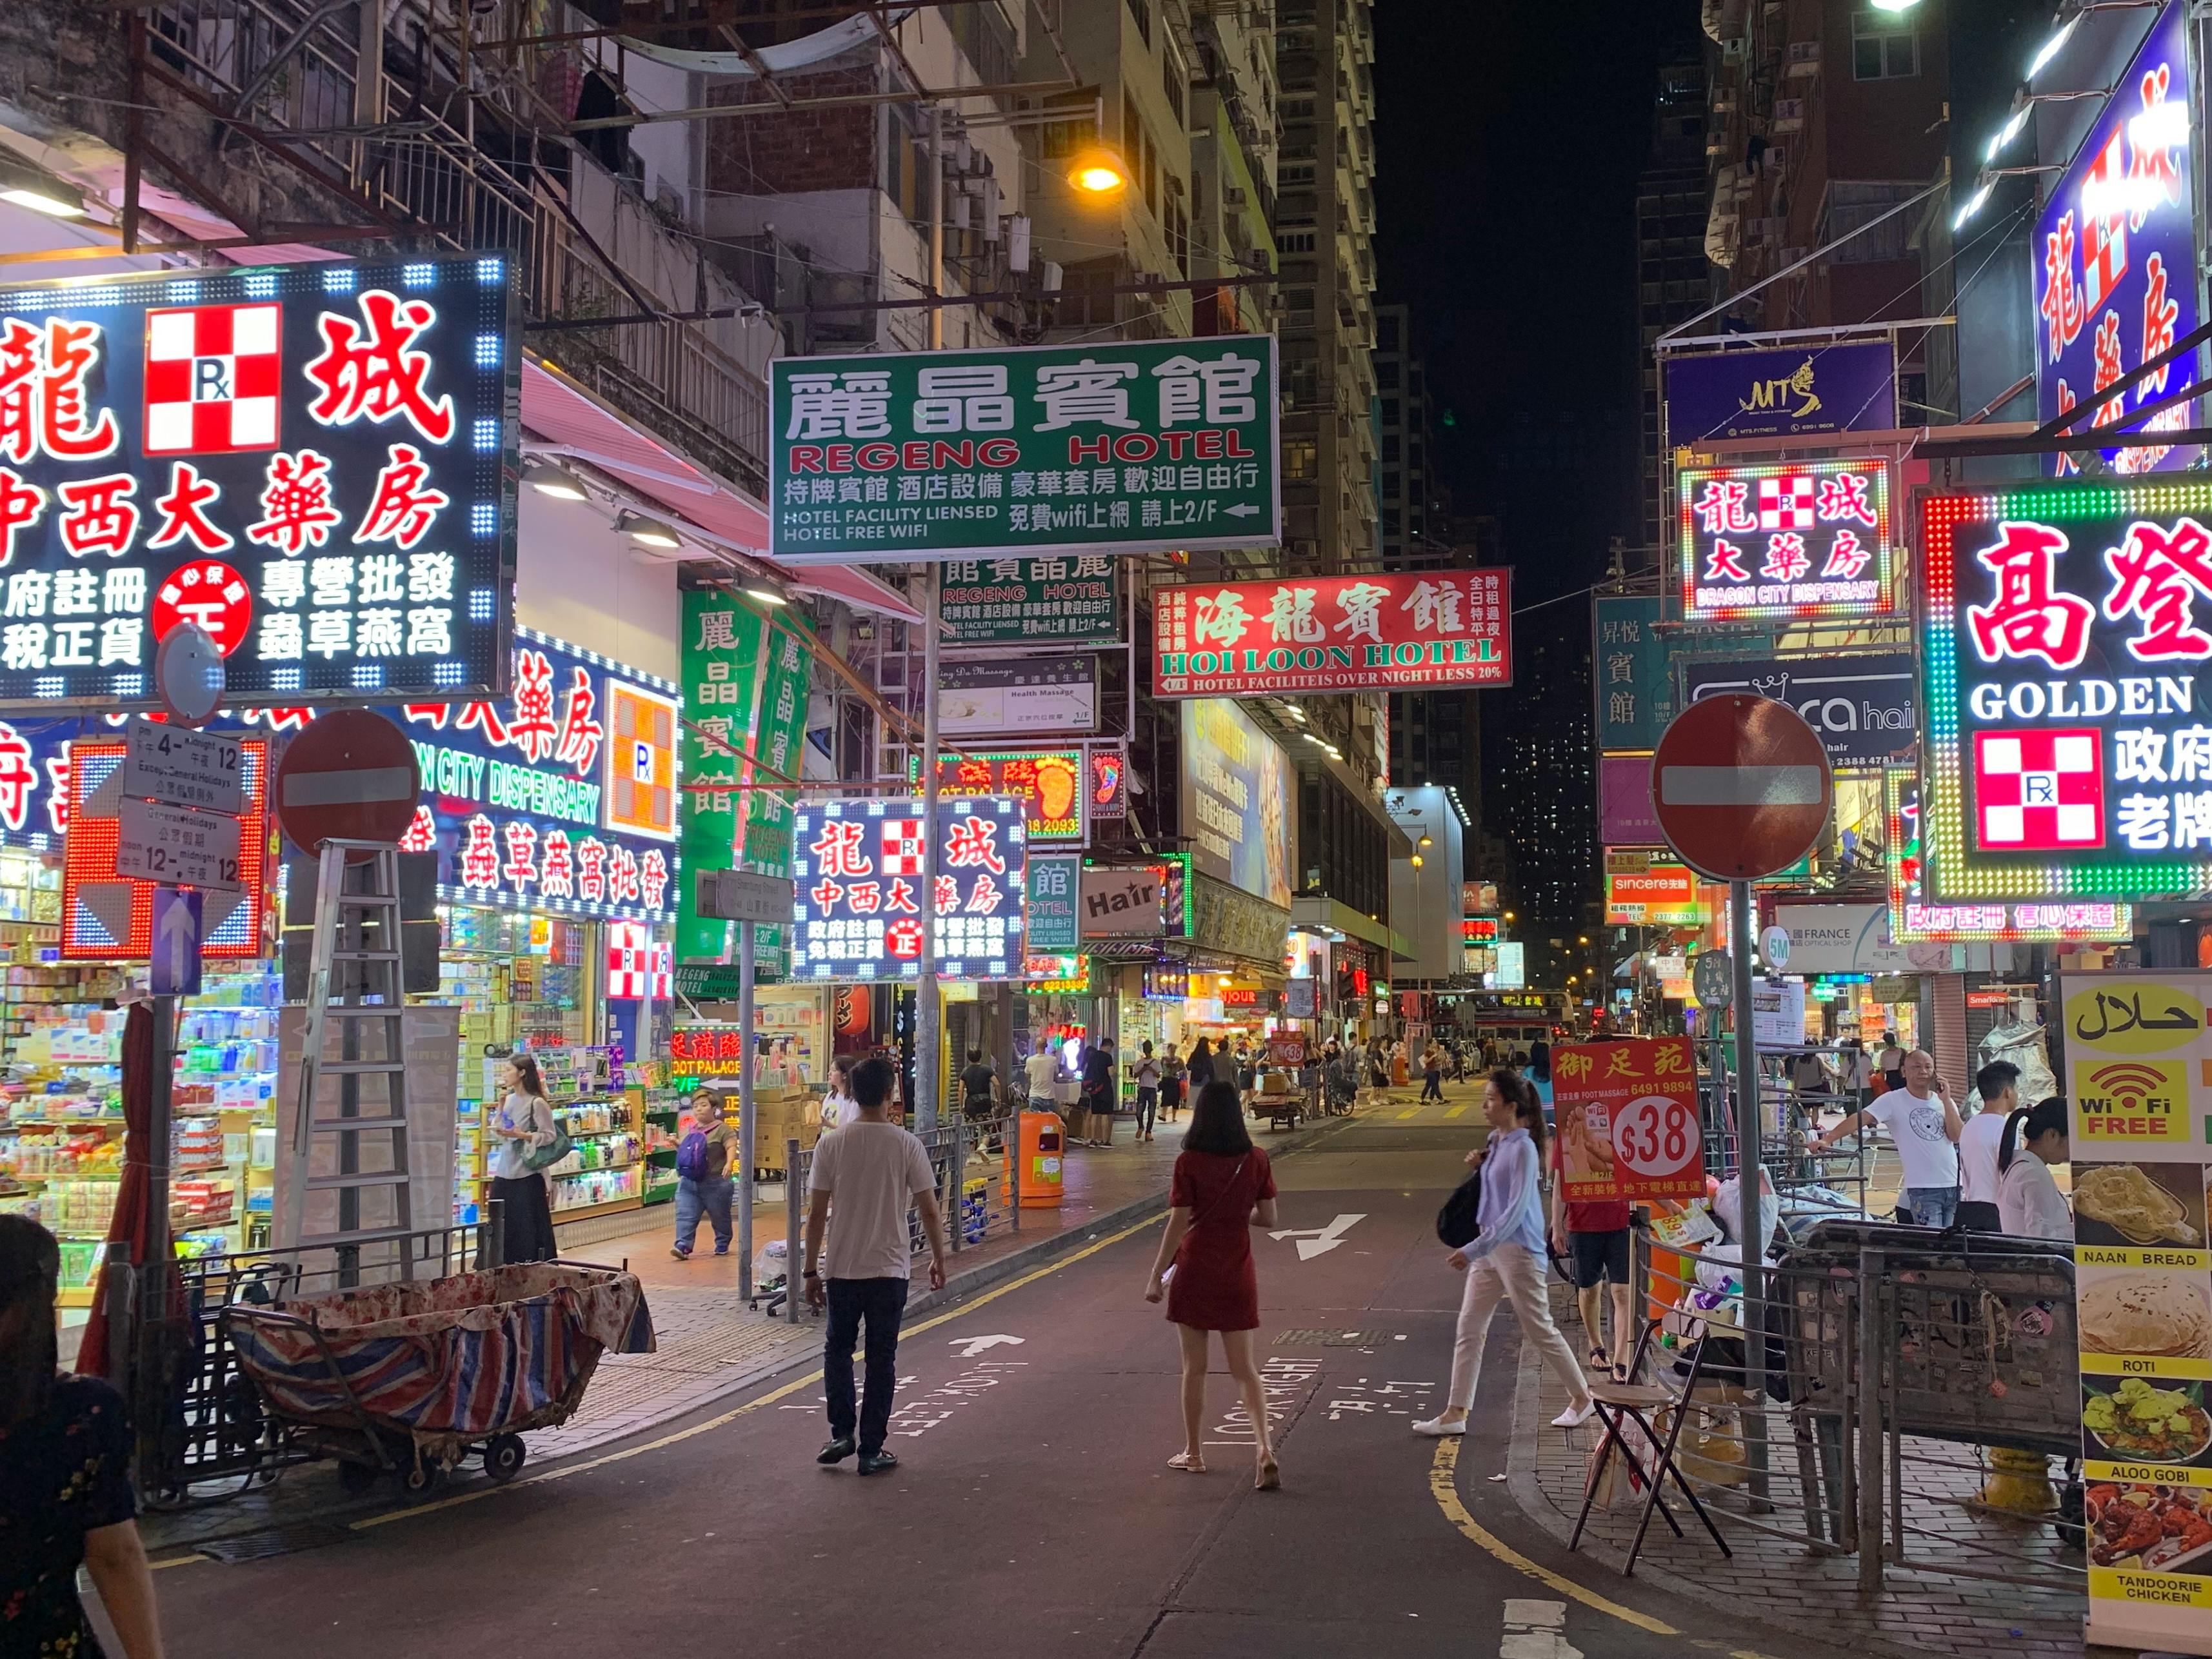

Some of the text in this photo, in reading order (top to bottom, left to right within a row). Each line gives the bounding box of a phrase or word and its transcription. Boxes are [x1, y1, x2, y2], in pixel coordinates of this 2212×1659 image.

[2041, 210, 2084, 366] 龍
[0, 316, 119, 464] 龍
[303, 289, 455, 444] 城
[785, 352, 1261, 439] 麗晶賓館
[788, 428, 1256, 474] REGENG HOTEL
[784, 462, 1260, 506] 持牌賓館 酒店設備 豪華套房 歡迎自由行
[0, 443, 450, 563] 中西大藥房
[782, 503, 999, 526] HOTEL FACILITY LIENSED
[1141, 499, 1218, 528] 請上2/F
[1694, 481, 1757, 534] 龍
[1818, 472, 1877, 526] 城
[783, 523, 928, 542] HOTEL FREE WIFI
[1704, 530, 1871, 581] 大藥房
[0, 552, 455, 617] 府註冊 專營批發
[943, 581, 1111, 604] REGENG HOTEL
[1696, 580, 1880, 606] DRAGON CITY DISPENSARY
[1968, 519, 2212, 670] 高登
[983, 603, 1021, 619] 酒店設備
[1063, 599, 1111, 615] 歡迎自由行
[1194, 580, 1466, 648] 海龍賓館
[1470, 577, 1484, 637] 全日特平
[1486, 576, 1500, 637] 時租過夜
[258, 605, 452, 661] 蟲草燕窩
[965, 619, 1019, 630] FACILITY LIENSED
[1158, 591, 1171, 651] 酒店設備
[964, 630, 979, 639] FREE
[1160, 638, 1502, 677] HOI LOON HOTEL
[972, 666, 1014, 677] Massage
[1193, 678, 1244, 692] HOTEL
[1248, 675, 1333, 690] FACILITEIS
[1336, 673, 1378, 686] OVER
[1381, 670, 1433, 684] NIGHT
[1436, 668, 1474, 681] LESS
[1478, 666, 1502, 679] 20%
[1970, 676, 2194, 719] GOLDEN
[693, 610, 740, 817] 麗晶賓館
[139, 726, 152, 737] pm
[760, 634, 802, 824] 麗晶賓館
[191, 753, 209, 768] 午夜
[219, 747, 237, 771] 12
[1837, 757, 1866, 766] 2388
[198, 773, 231, 788] Holidays
[437, 746, 485, 802] CITY
[488, 760, 601, 826] DISPENSARY
[121, 840, 142, 851] noon
[179, 849, 215, 863] midnight
[810, 820, 873, 877] 龍
[945, 816, 1006, 875] 城
[219, 858, 237, 882] 12
[461, 813, 669, 911] 蟲草燕窩批發
[811, 874, 1004, 917] 中西大藥房
[1615, 879, 1668, 889] sincere
[1087, 879, 1154, 919] Hair
[1906, 903, 2116, 930] 政府註冊 信心保證
[895, 933, 916, 955] 正
[1804, 929, 1851, 939] FRANCE
[1770, 938, 1788, 959] 5M
[675, 968, 710, 982] REGENG
[2076, 991, 2198, 1041] حلال
[1557, 1043, 1693, 1084] 御足苑
[1582, 1088, 1629, 1100] FOOT MASSAGE
[1631, 1083, 1659, 1095] 6491
[1663, 1081, 1693, 1094] 9894
[1621, 1102, 1686, 1165] $38
[2088, 1117, 2167, 1135] FREE
[1623, 1180, 1703, 1195] 地下電梯直達
[2084, 1250, 2197, 1266] NAAN BREAD
[2123, 1360, 2155, 1373] ROTI
[2111, 1465, 2189, 1483] ALOO GOBI
[2117, 1575, 2202, 1593] TANDOORIE
[2126, 1587, 2191, 1604] CHICKEN
